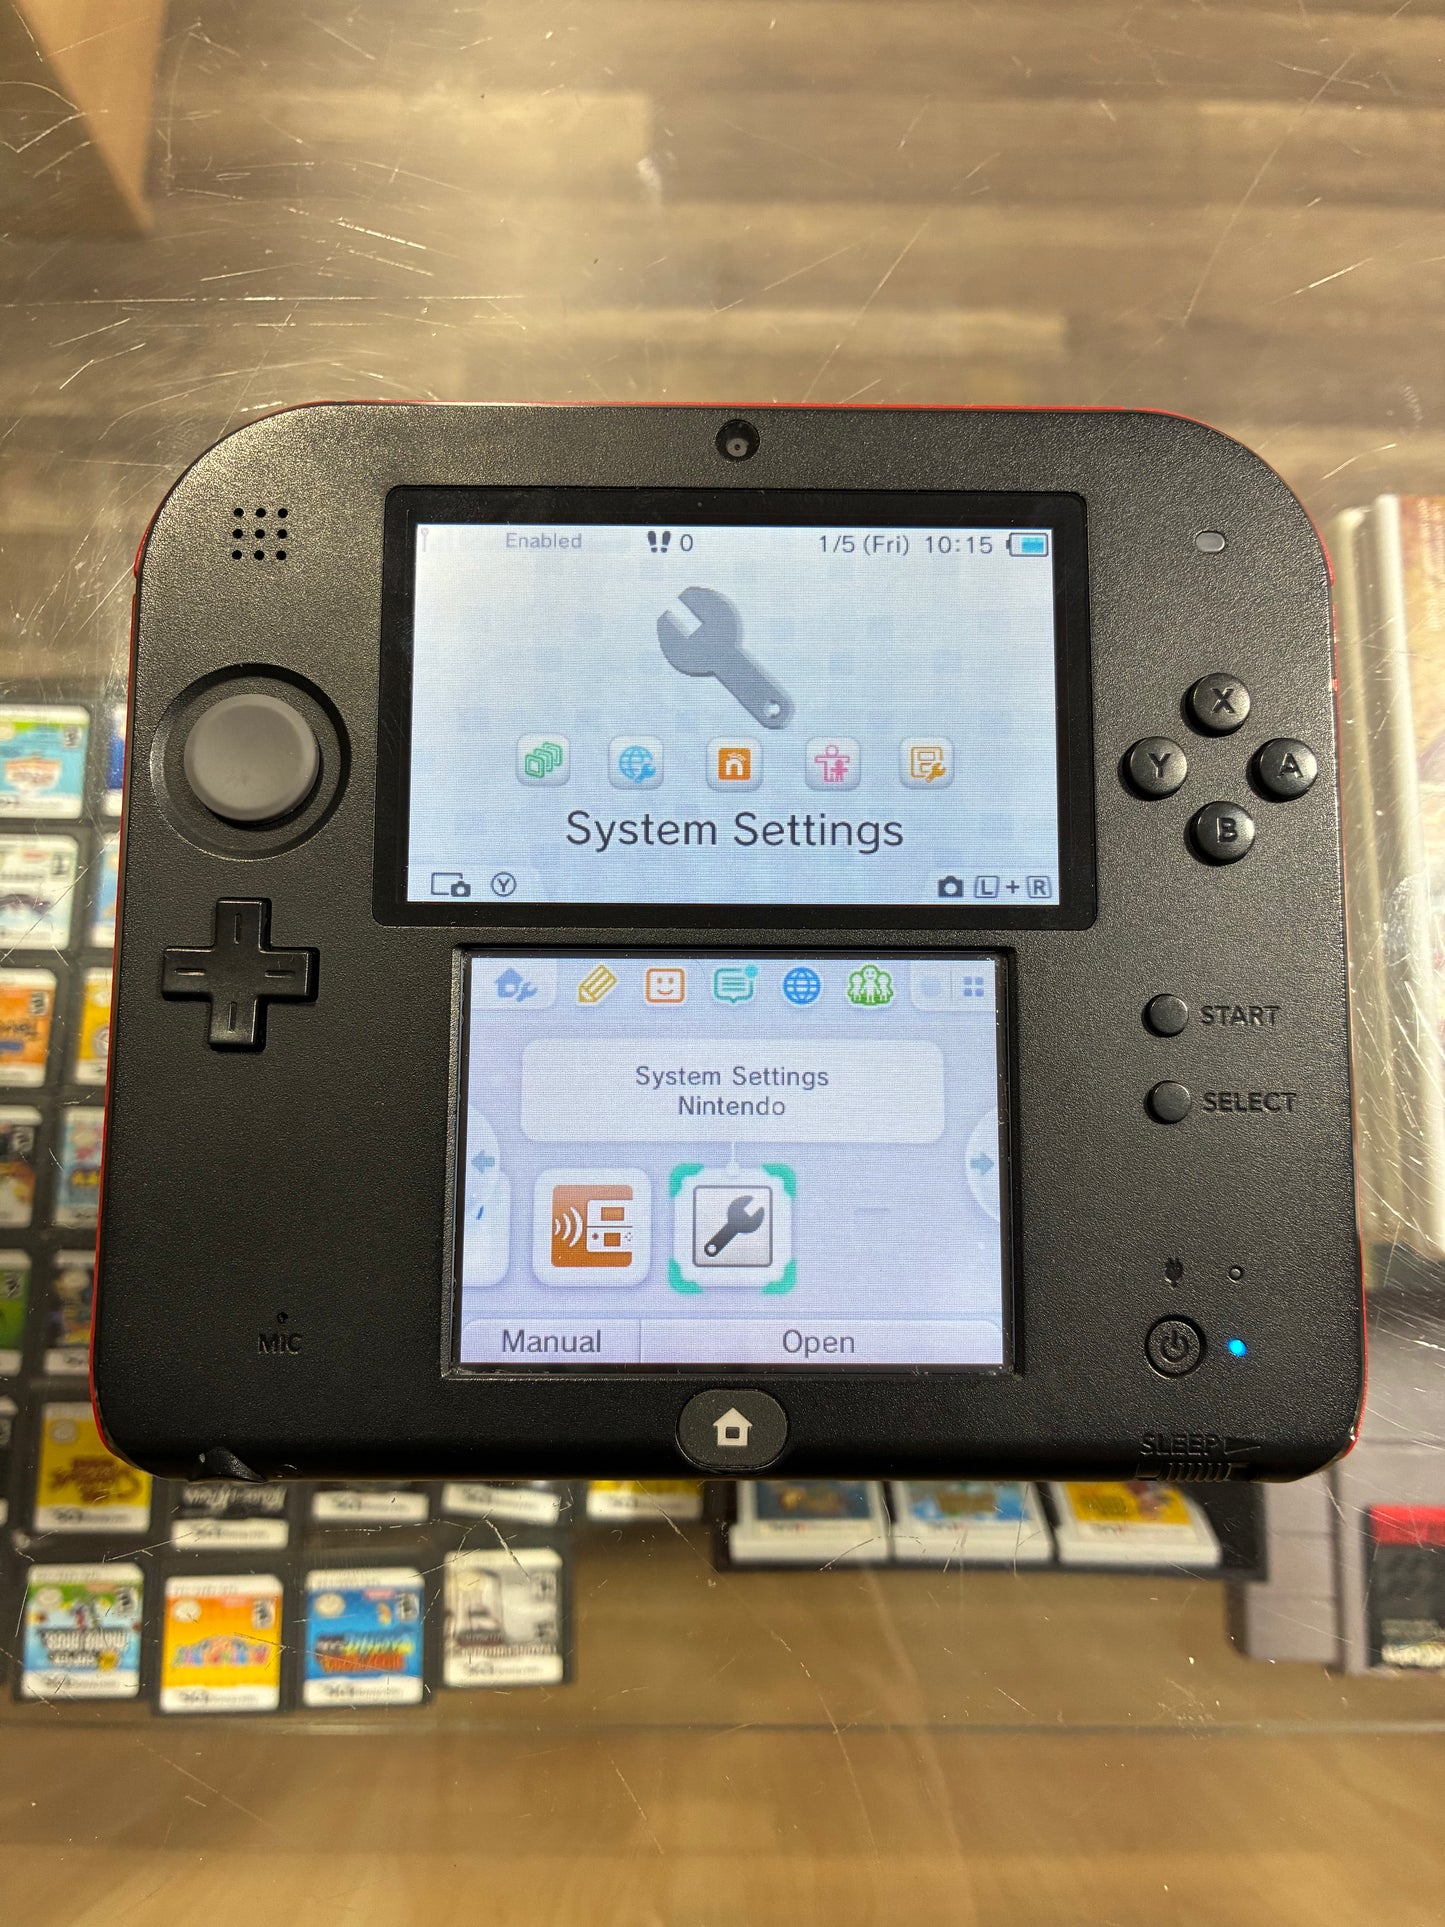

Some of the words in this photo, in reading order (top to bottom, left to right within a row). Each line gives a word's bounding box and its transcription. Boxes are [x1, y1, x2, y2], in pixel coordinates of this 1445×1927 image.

[505, 531, 582, 550] Enabled
[679, 533, 694, 553] 0
[818, 533, 857, 556] 1/5
[863, 533, 910, 558] (Fri)
[925, 534, 994, 556] 10:15
[1212, 688, 1235, 714] X
[1147, 752, 1173, 779] Y
[1275, 752, 1304, 780] A
[565, 810, 718, 853] System
[732, 811, 905, 855] Settings
[1216, 816, 1238, 843] B
[1201, 1005, 1281, 1027] START
[635, 1066, 722, 1090] System
[732, 1067, 830, 1091] Settings
[678, 1095, 787, 1117] Nintendo
[1202, 1091, 1298, 1114] SELECT
[257, 1332, 303, 1355] MIC
[501, 1329, 602, 1354] Manual
[782, 1330, 856, 1358] Open
[1140, 1433, 1221, 1457] SLEEP
